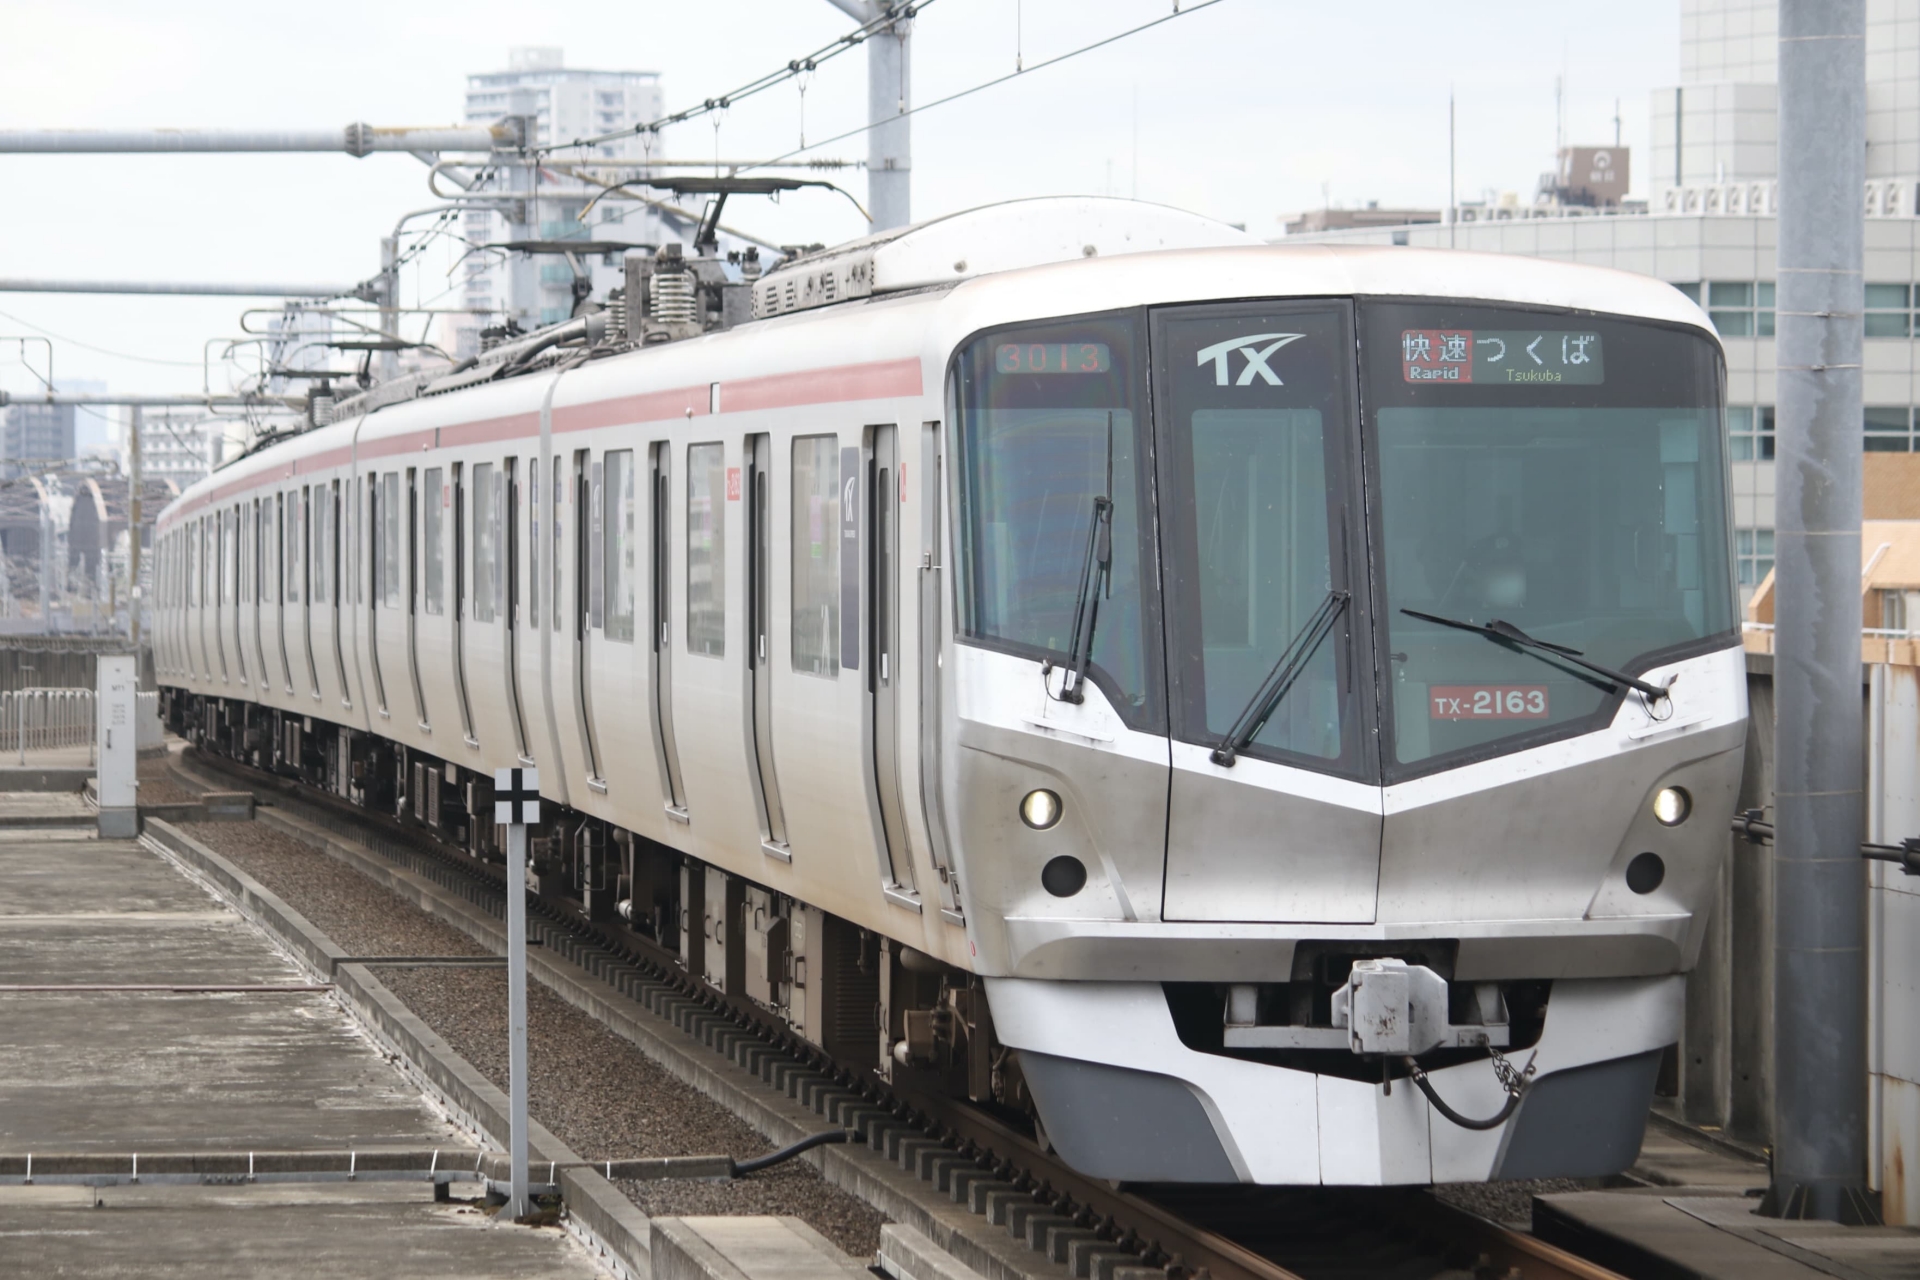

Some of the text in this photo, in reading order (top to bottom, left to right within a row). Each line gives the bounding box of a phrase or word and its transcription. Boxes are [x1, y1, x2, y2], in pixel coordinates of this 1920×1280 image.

[1002, 343, 1099, 372] 3013
[1197, 332, 1307, 386] TX
[1402, 333, 1467, 362] 快速
[1476, 335, 1595, 366] つくば
[1409, 366, 1459, 379] Rapid
[1506, 368, 1562, 382] Tsukuba
[1434, 690, 1546, 714] TX-2163
